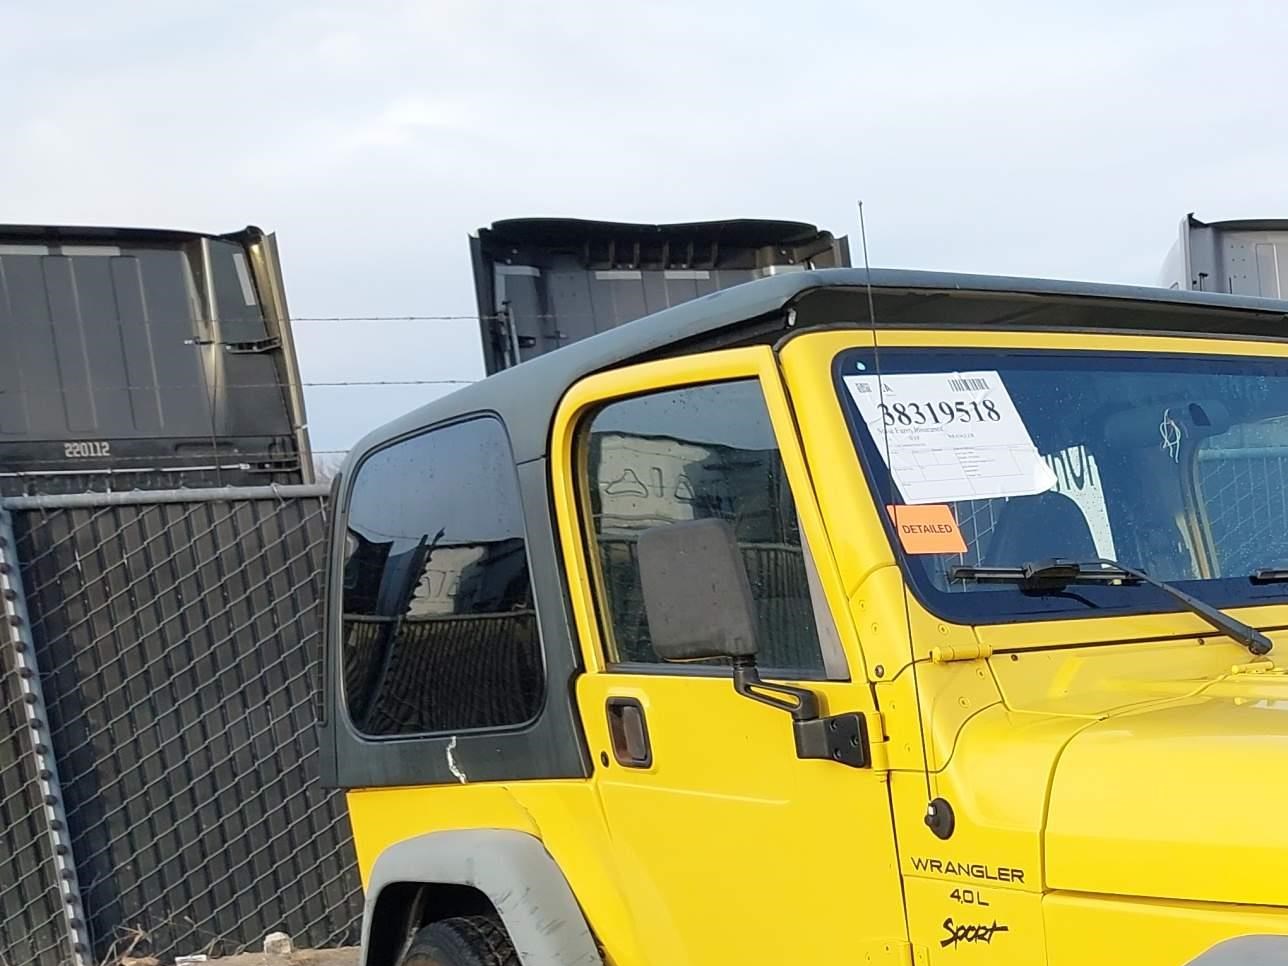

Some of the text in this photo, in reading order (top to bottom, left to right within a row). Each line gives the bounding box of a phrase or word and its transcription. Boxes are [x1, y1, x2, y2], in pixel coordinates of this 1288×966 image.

[876, 400, 1001, 425] 38319518
[64, 441, 111, 458] 220112
[902, 524, 953, 534] DETAILED
[910, 856, 1025, 883] WRANGLER
